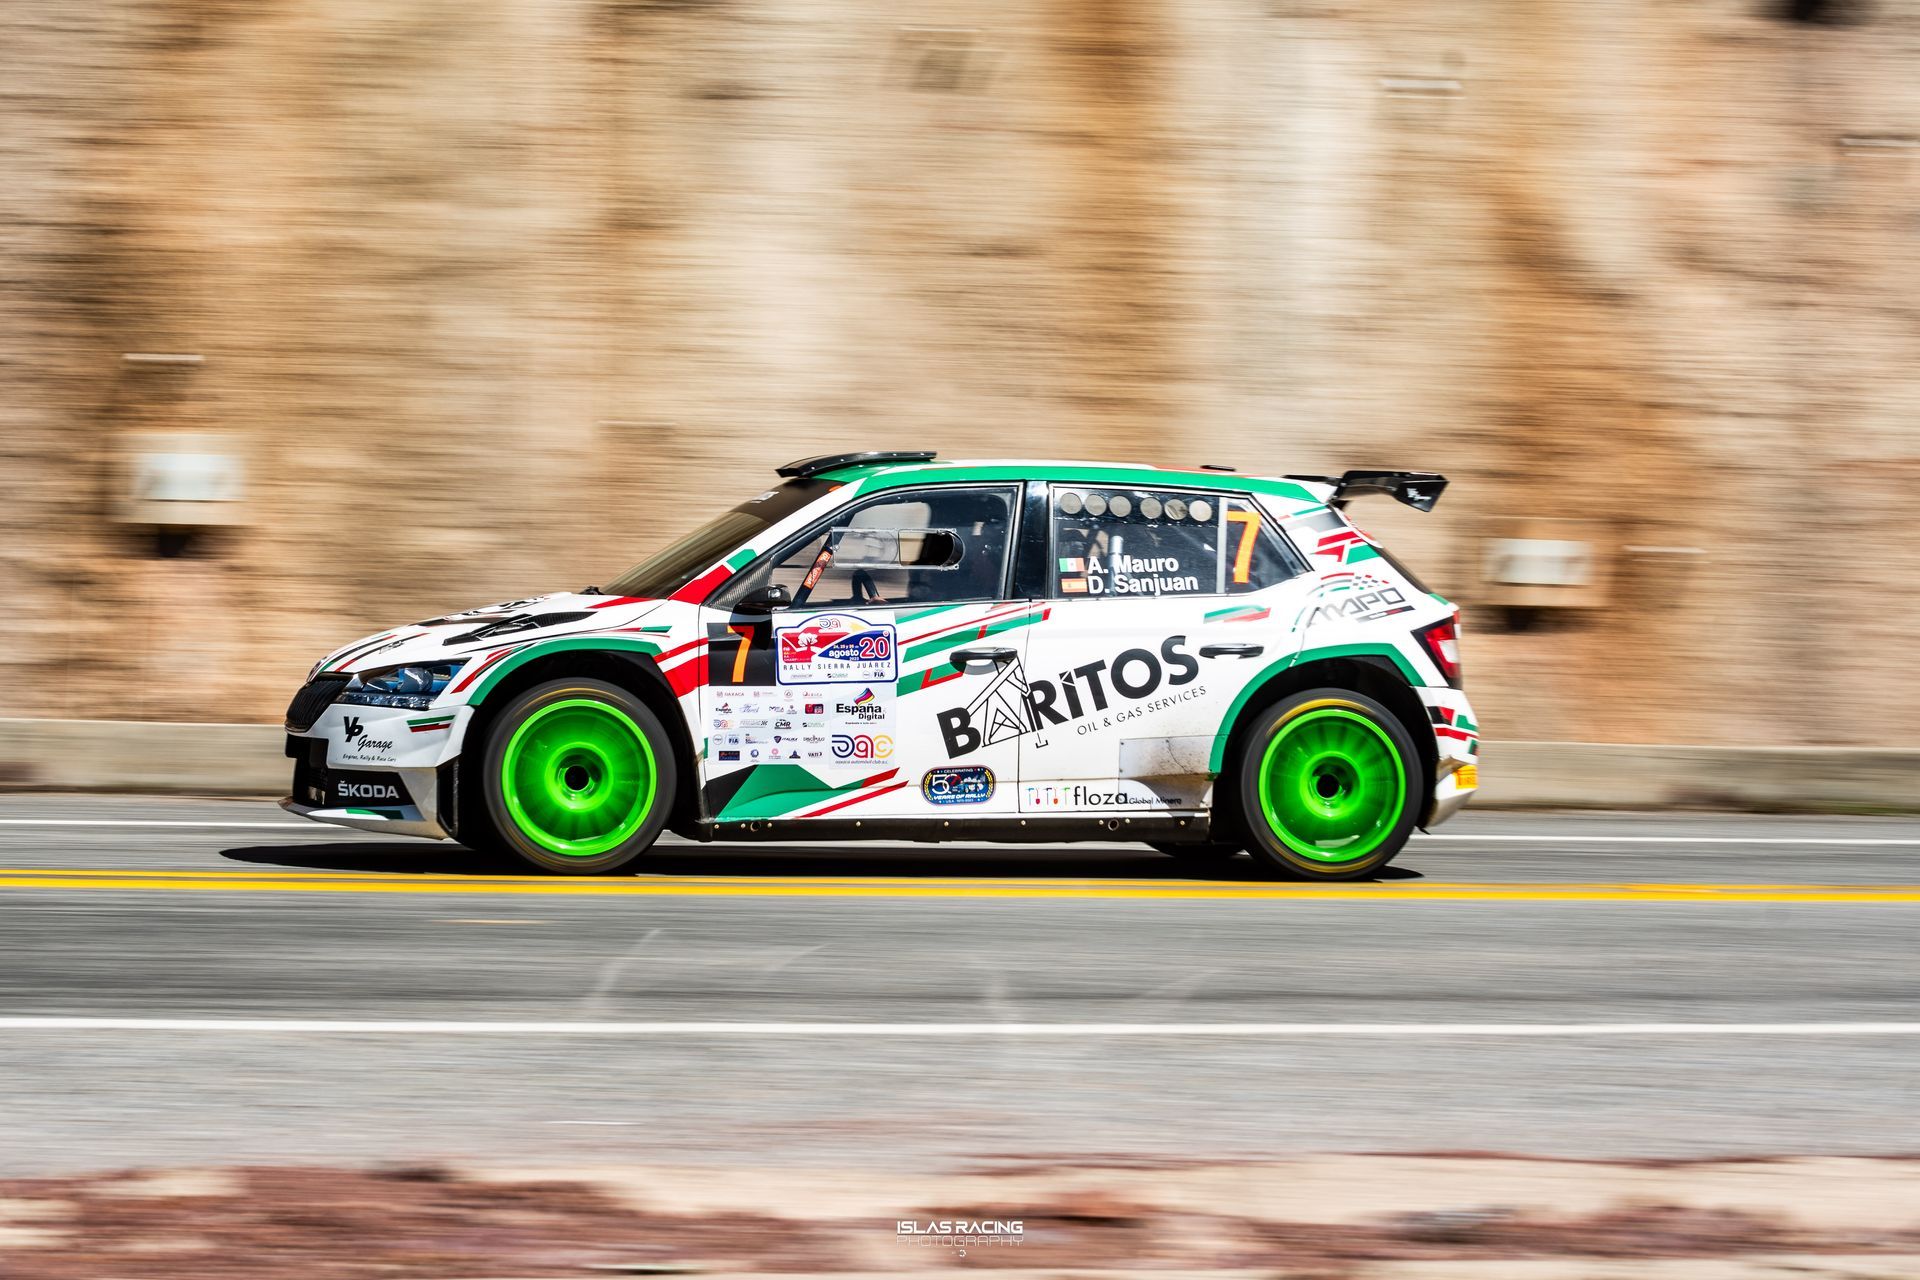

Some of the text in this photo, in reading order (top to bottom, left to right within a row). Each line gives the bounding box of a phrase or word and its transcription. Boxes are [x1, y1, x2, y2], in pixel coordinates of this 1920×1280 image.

[1227, 509, 1262, 583] 7
[1087, 555, 1179, 574] A. Mauro
[1088, 575, 1199, 596] D. Sanjuan
[726, 625, 755, 683] 7
[828, 649, 859, 658] agosto
[817, 662, 851, 670] SIERRA
[857, 660, 891, 669] JUÁREZ
[836, 703, 882, 715] España
[858, 712, 885, 721] Digital
[1077, 686, 1207, 735] OIL & GAS SERVICES
[357, 734, 393, 753] Garage
[338, 780, 400, 799] ŠKODA
[1073, 786, 1129, 806] floza
[1128, 796, 1153, 805] Global
